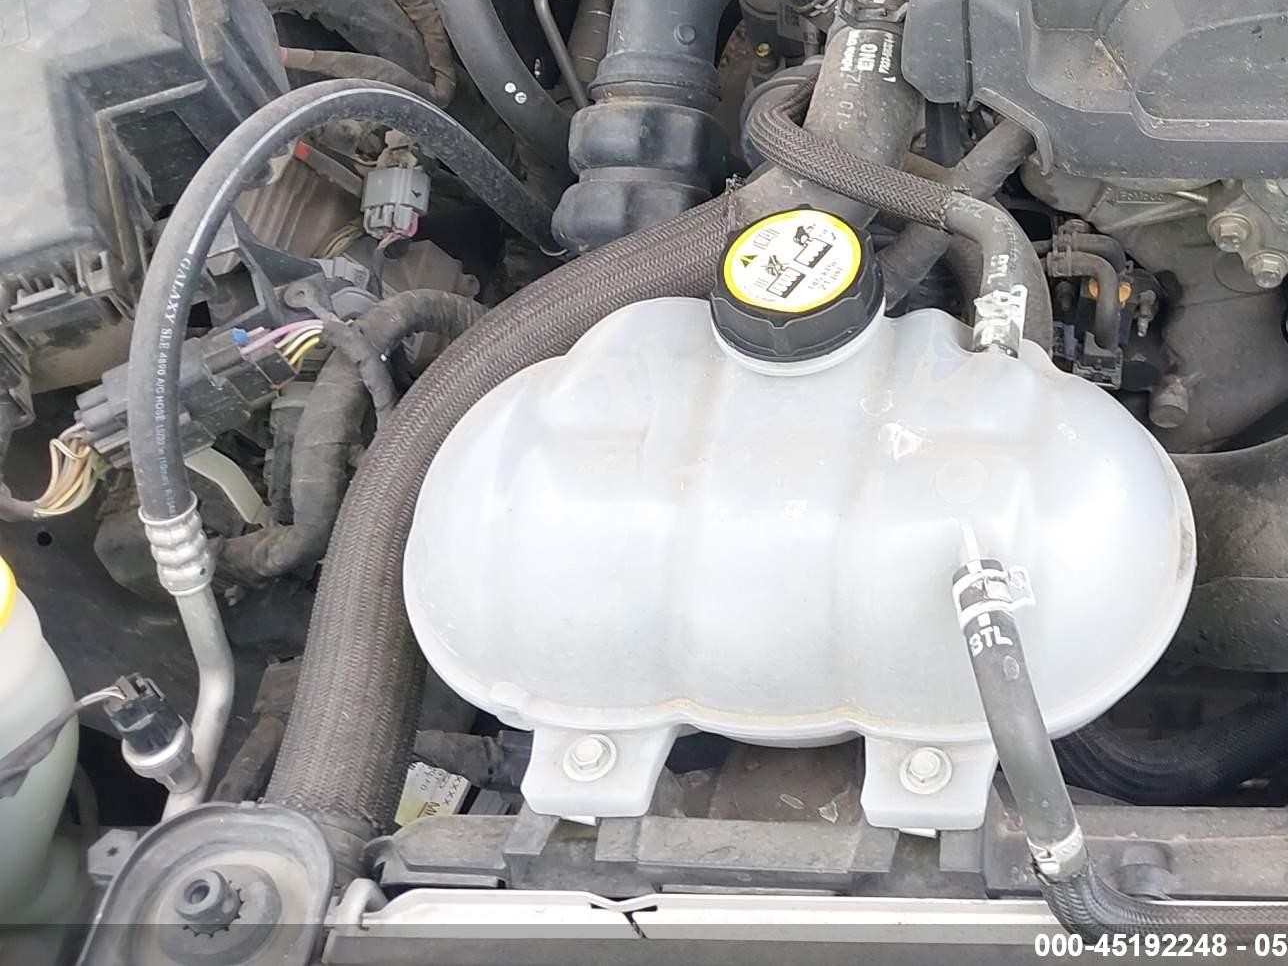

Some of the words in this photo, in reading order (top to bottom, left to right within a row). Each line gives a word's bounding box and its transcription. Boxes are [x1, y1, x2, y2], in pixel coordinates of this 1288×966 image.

[165, 257, 191, 324] GALAXY
[155, 378, 166, 394] A/C
[154, 395, 166, 422] HOSE
